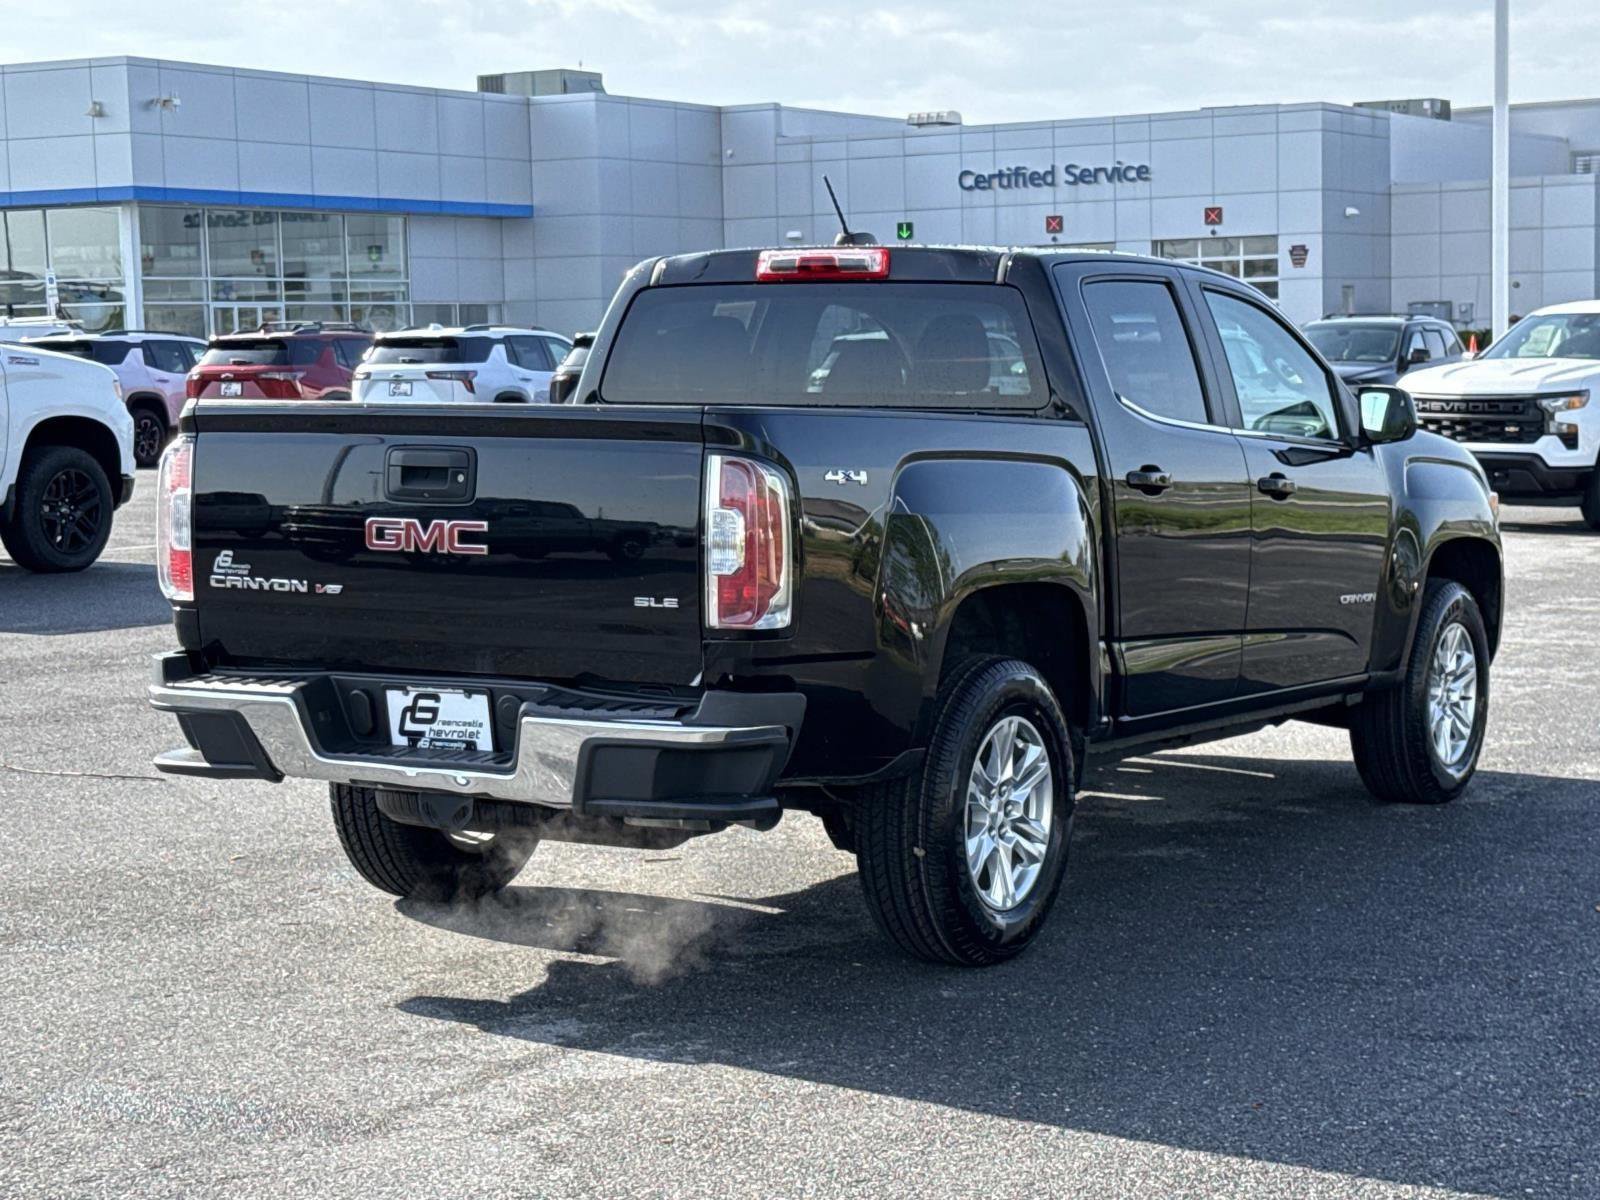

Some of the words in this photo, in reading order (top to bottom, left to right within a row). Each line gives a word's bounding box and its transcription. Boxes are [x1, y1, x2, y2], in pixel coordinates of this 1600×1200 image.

[958, 165, 1056, 191] Certified
[1064, 161, 1152, 186] Service
[365, 517, 488, 555] GMC
[210, 575, 308, 592] CANYON
[633, 596, 679, 608] SLE
